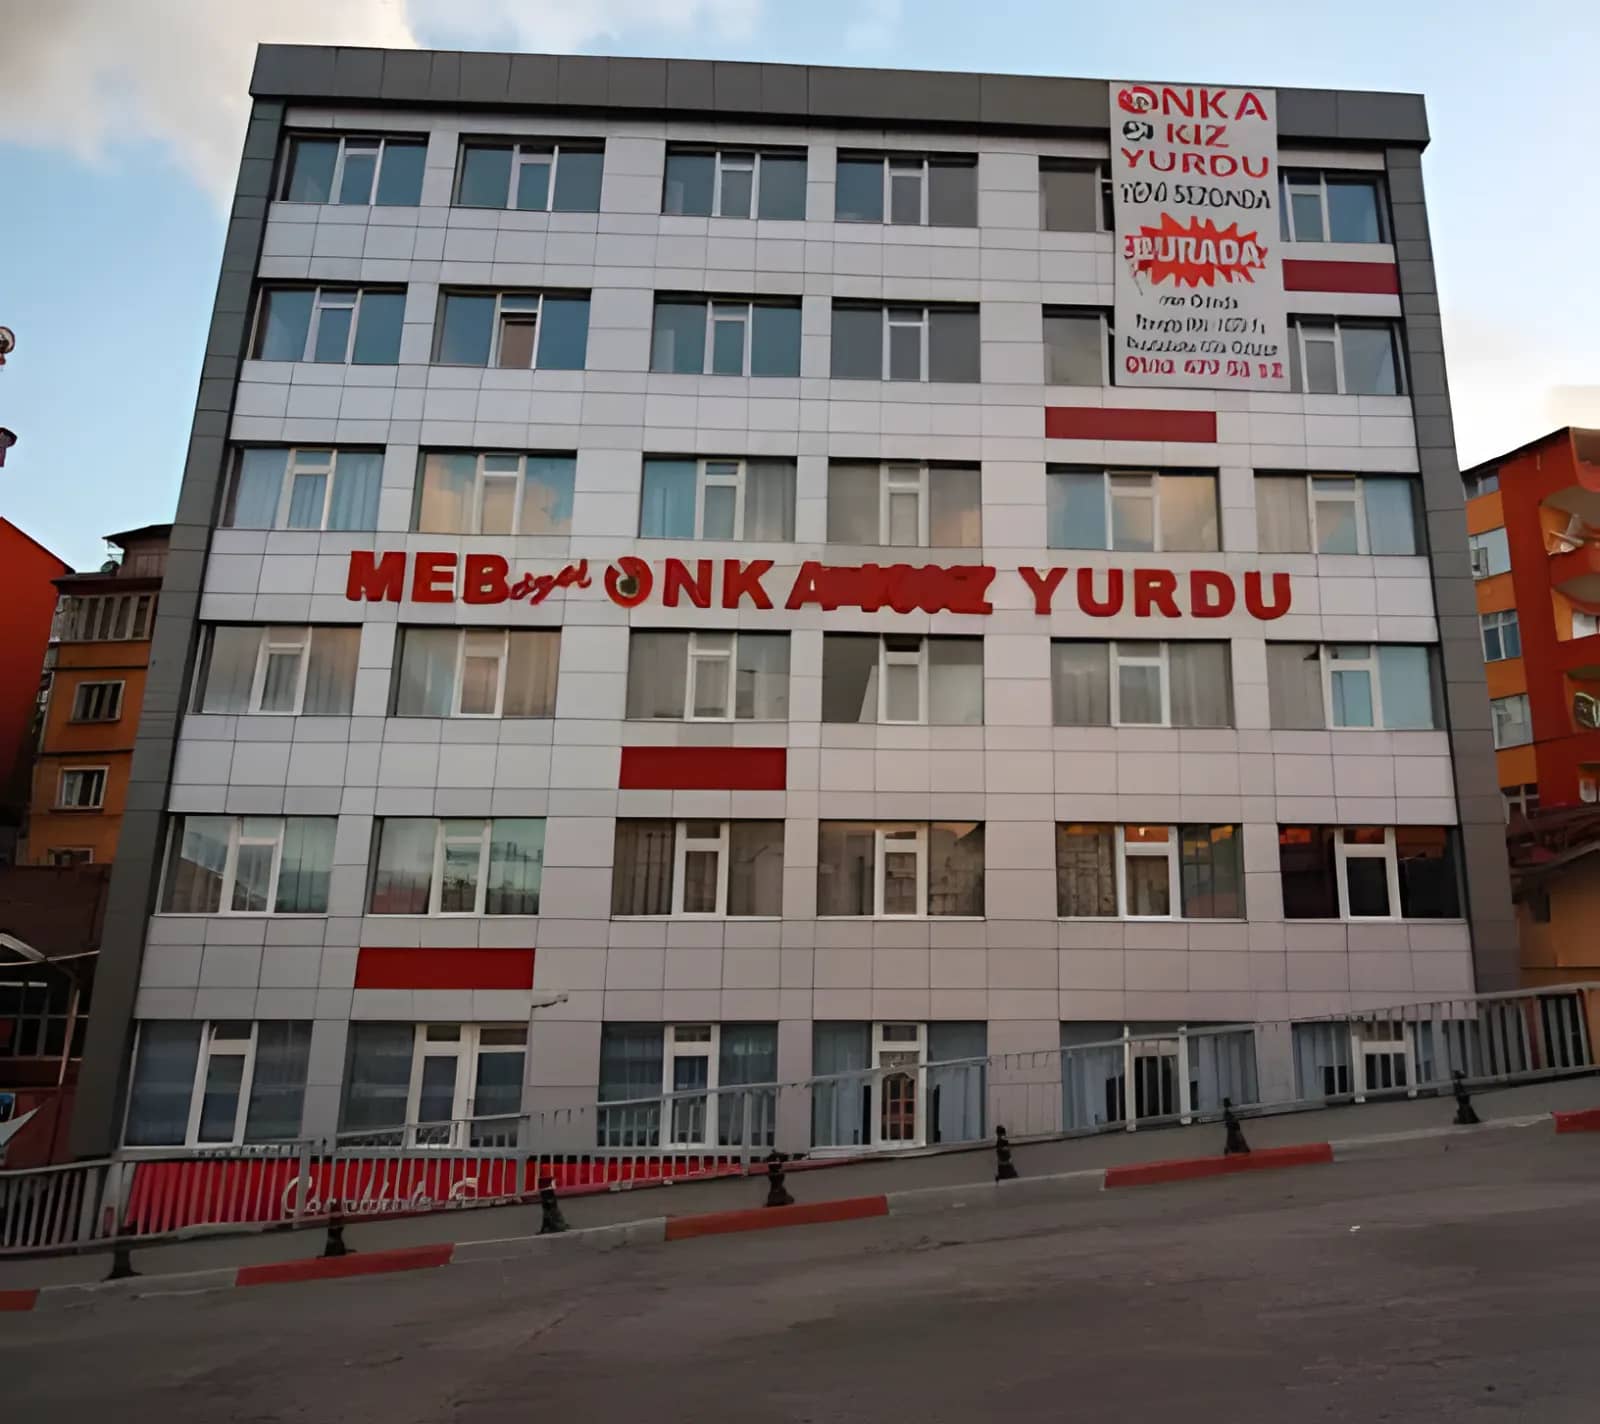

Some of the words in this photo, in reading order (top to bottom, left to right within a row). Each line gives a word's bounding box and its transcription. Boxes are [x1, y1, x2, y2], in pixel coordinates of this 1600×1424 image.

[1117, 86, 1268, 121] ONKA
[1167, 123, 1229, 148] KIZ
[1121, 147, 1269, 179] YURDU
[346, 550, 509, 604] MEB
[1018, 566, 1292, 621] YURDU
